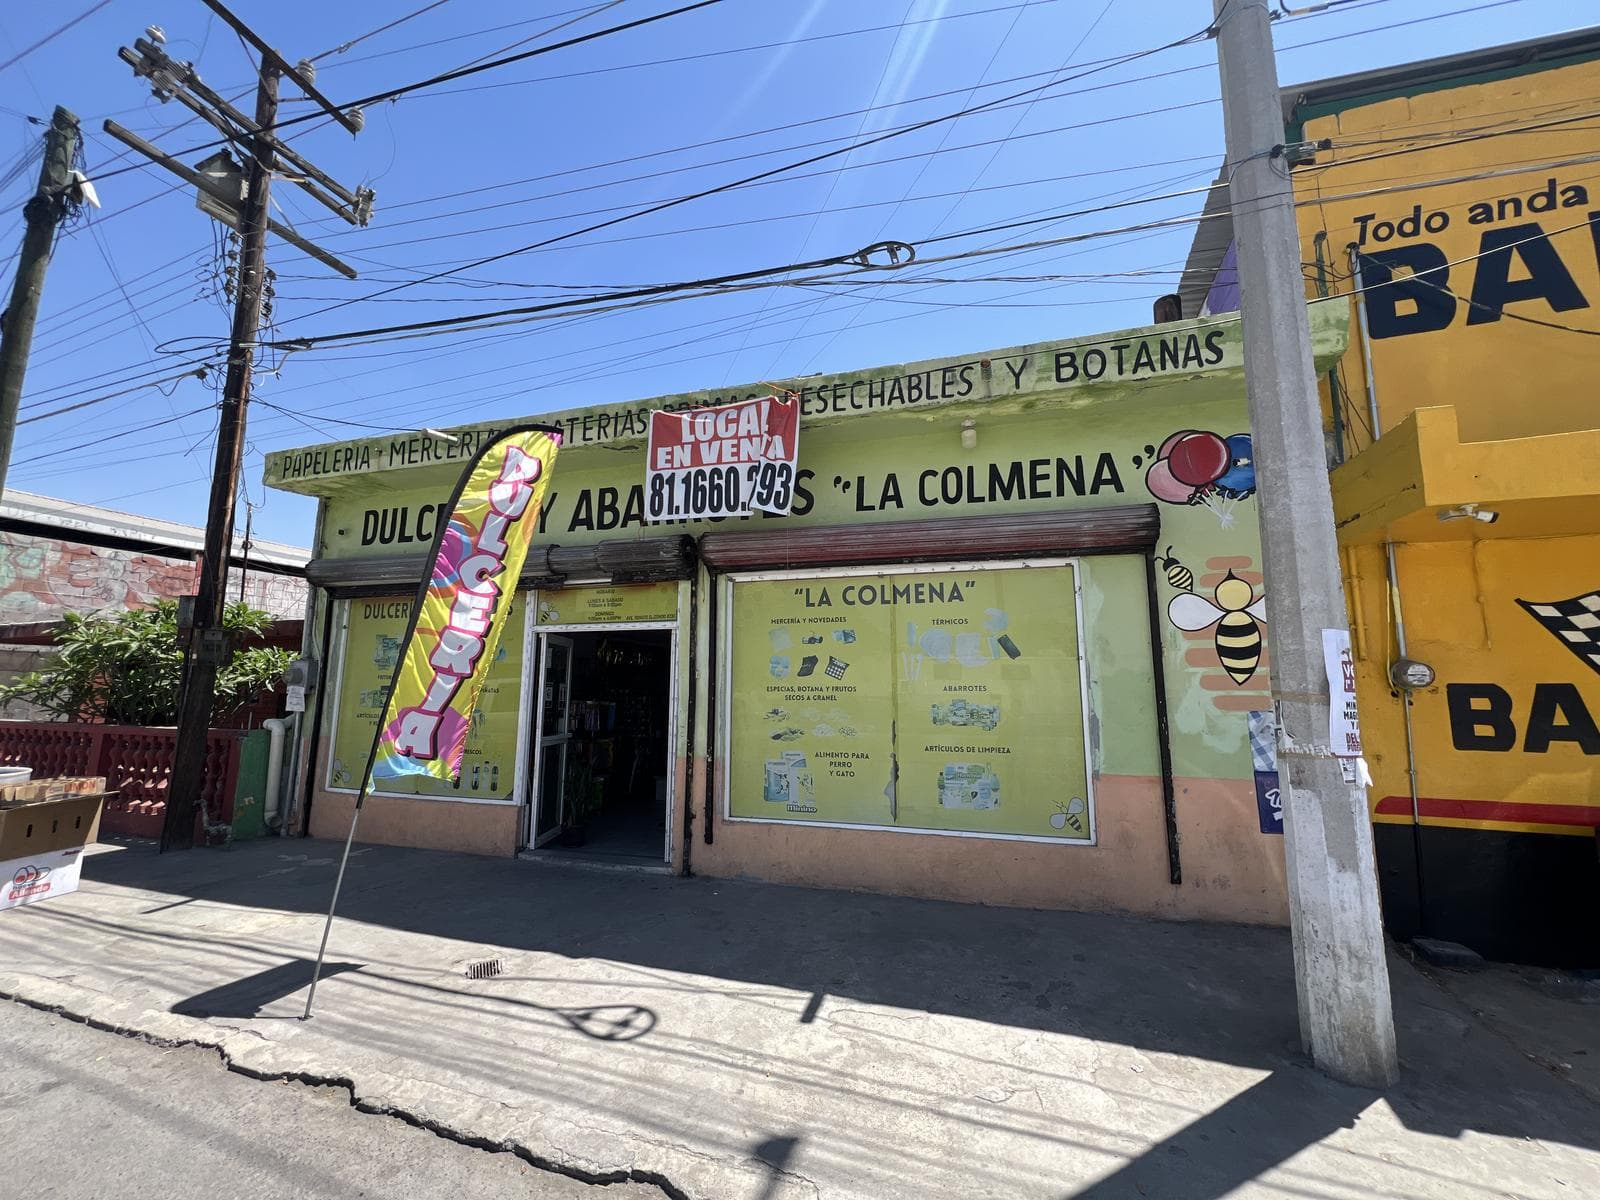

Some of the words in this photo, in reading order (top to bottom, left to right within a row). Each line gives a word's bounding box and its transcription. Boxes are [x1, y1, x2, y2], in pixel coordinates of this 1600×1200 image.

[1353, 205, 1450, 246] Todo
[1467, 178, 1589, 225] anda
[1358, 210, 1600, 340] BA
[282, 446, 370, 480] PAPELERIA
[1005, 358, 1028, 390] Y
[1055, 330, 1224, 384] BOTANAS
[656, 444, 692, 469] EN
[538, 492, 558, 534] Y
[364, 598, 414, 620] DULCERÍ
[395, 445, 542, 760] DULCERIA
[770, 616, 801, 625] MERCERÍA
[808, 616, 847, 624] NOVEDADES
[932, 617, 969, 626] TÉRMICOS
[831, 685, 857, 693] FRUTOS
[784, 694, 805, 702] SECOS
[812, 694, 838, 702] GRANEL
[814, 751, 850, 759] ALIMENTO
[851, 752, 870, 760] PARA
[924, 744, 965, 753] ARTÍCULOS
[977, 746, 1012, 754] LIMPIEZA
[835, 770, 856, 778] GATO
